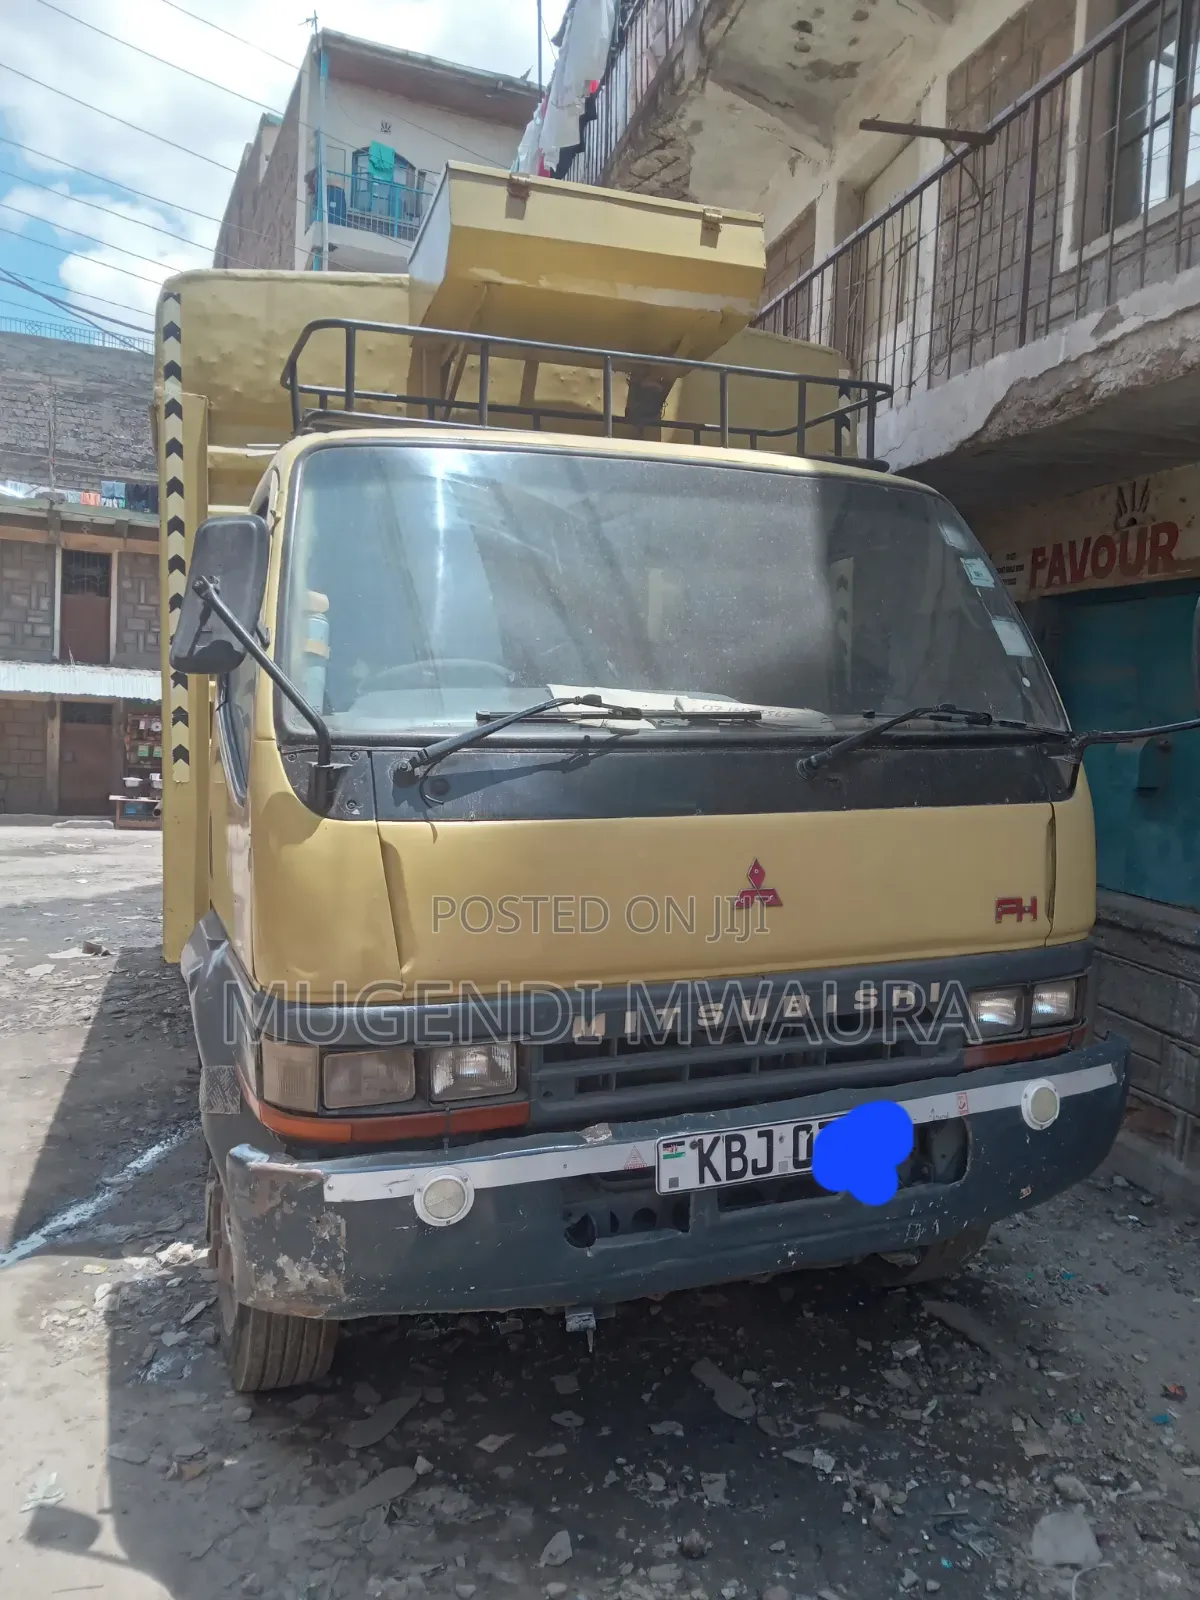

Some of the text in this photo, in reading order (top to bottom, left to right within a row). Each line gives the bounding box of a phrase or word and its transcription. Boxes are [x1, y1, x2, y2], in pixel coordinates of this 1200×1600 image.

[1029, 520, 1179, 591] FAVOUR
[995, 896, 1037, 924] FH
[572, 982, 941, 1038] MITSUBISHI
[697, 1129, 774, 1184] KBJ
